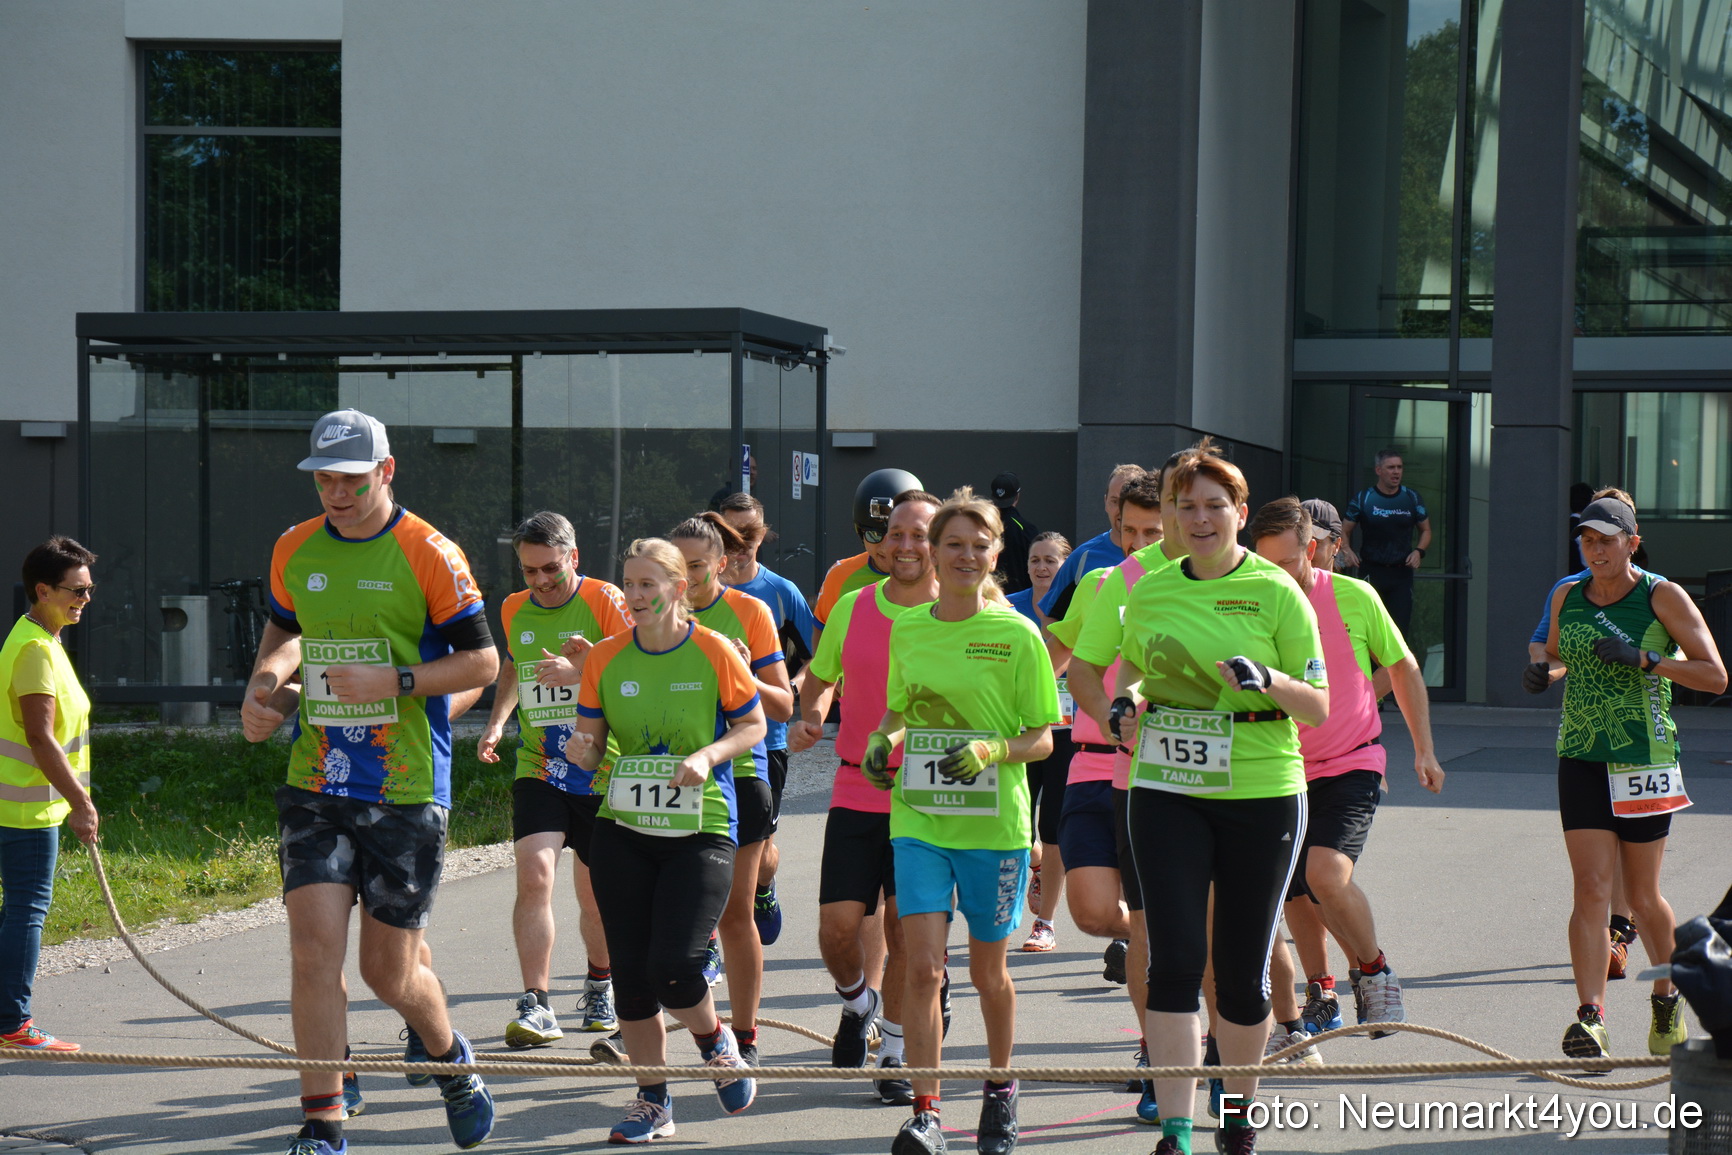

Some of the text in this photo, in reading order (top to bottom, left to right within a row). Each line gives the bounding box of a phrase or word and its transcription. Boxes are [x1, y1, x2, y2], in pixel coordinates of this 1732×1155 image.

[322, 425, 352, 438] NIKE
[357, 579, 393, 591] BOCK
[1595, 611, 1635, 644] Pyraser
[305, 642, 383, 663] BOCK
[965, 648, 1012, 657] ELEMENTELAUF
[968, 642, 1011, 650] NEUMARKTER
[532, 684, 573, 703] 115
[670, 682, 702, 691] BOCK
[314, 703, 386, 715] JONATHAN
[1642, 674, 1668, 744] Pyraser
[1159, 737, 1208, 765] 153
[1160, 768, 1205, 785] TANJA
[1628, 773, 1670, 796] 543
[629, 783, 681, 809] 112
[933, 793, 965, 805] ULLI
[637, 815, 671, 827] IRNA
